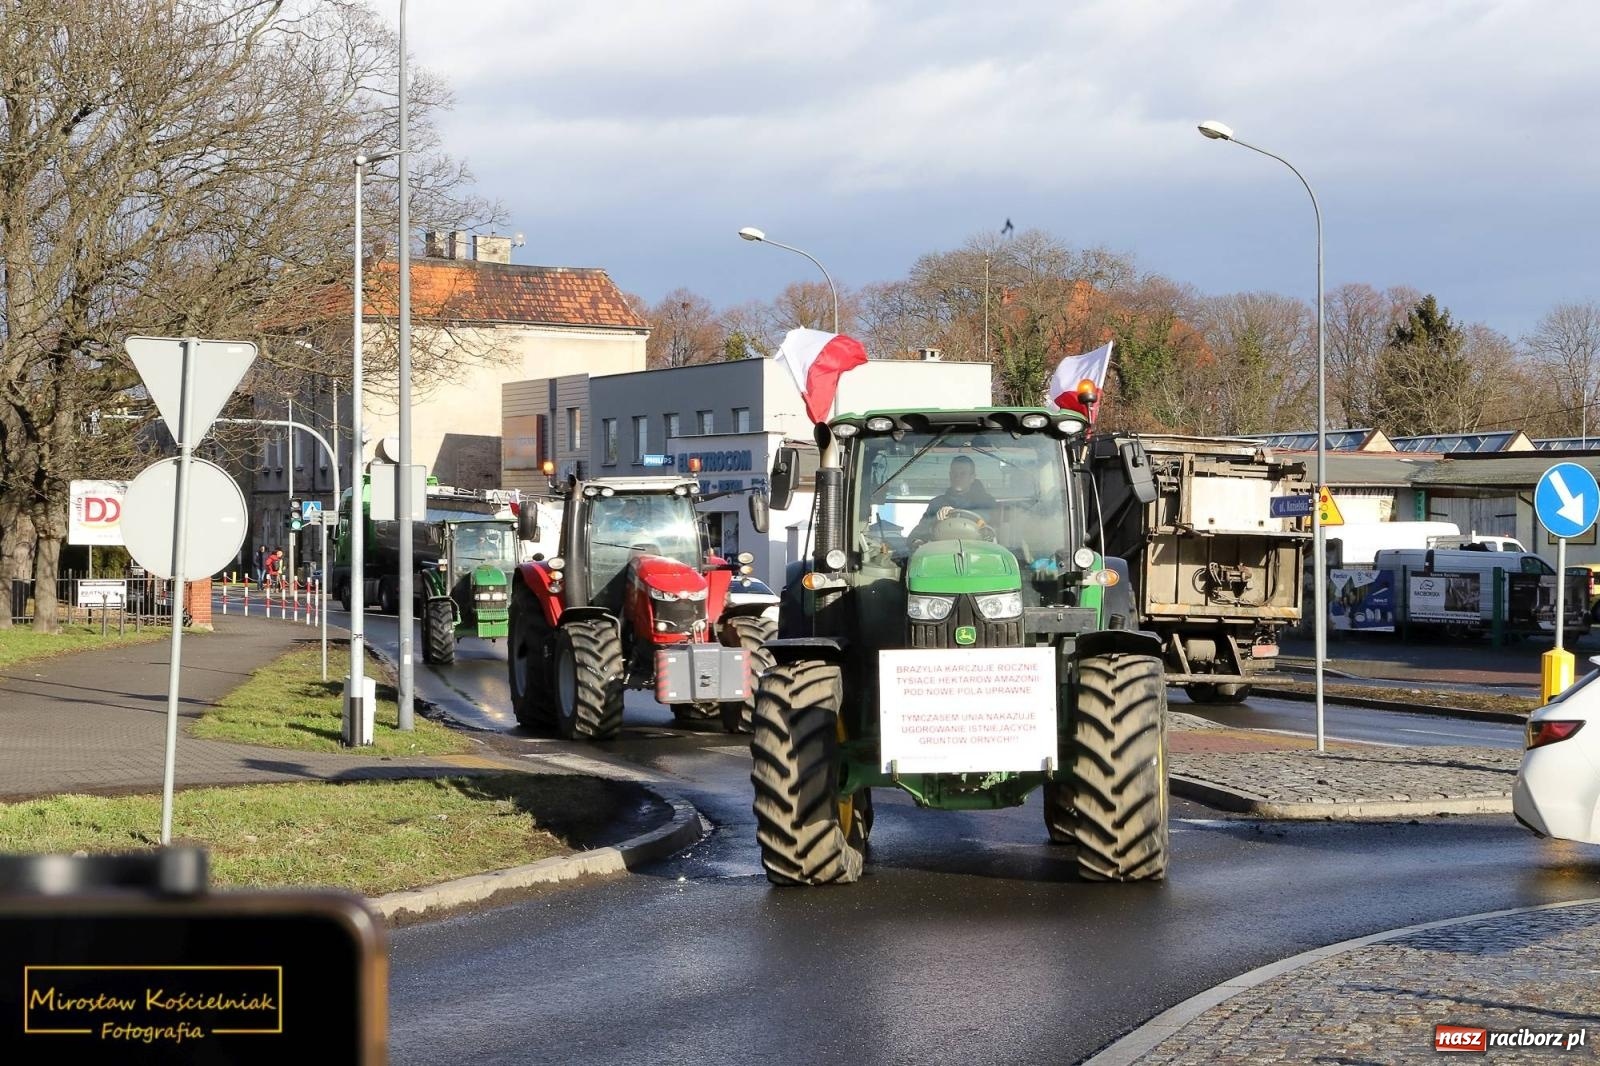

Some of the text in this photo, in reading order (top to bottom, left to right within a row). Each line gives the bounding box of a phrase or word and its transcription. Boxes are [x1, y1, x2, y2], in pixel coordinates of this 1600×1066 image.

[645, 456, 673, 465] PHILIPS
[896, 663, 1039, 674] BRAZYLIA KARCZUJE ROCZNIE
[994, 674, 1040, 683] AMAZONII
[904, 685, 1032, 697] POD NOWE POLA UPRAWNE
[901, 711, 1036, 722] TYMCZASEM UNIA NAKAZUJE
[901, 725, 966, 734] UGOROWANIE
